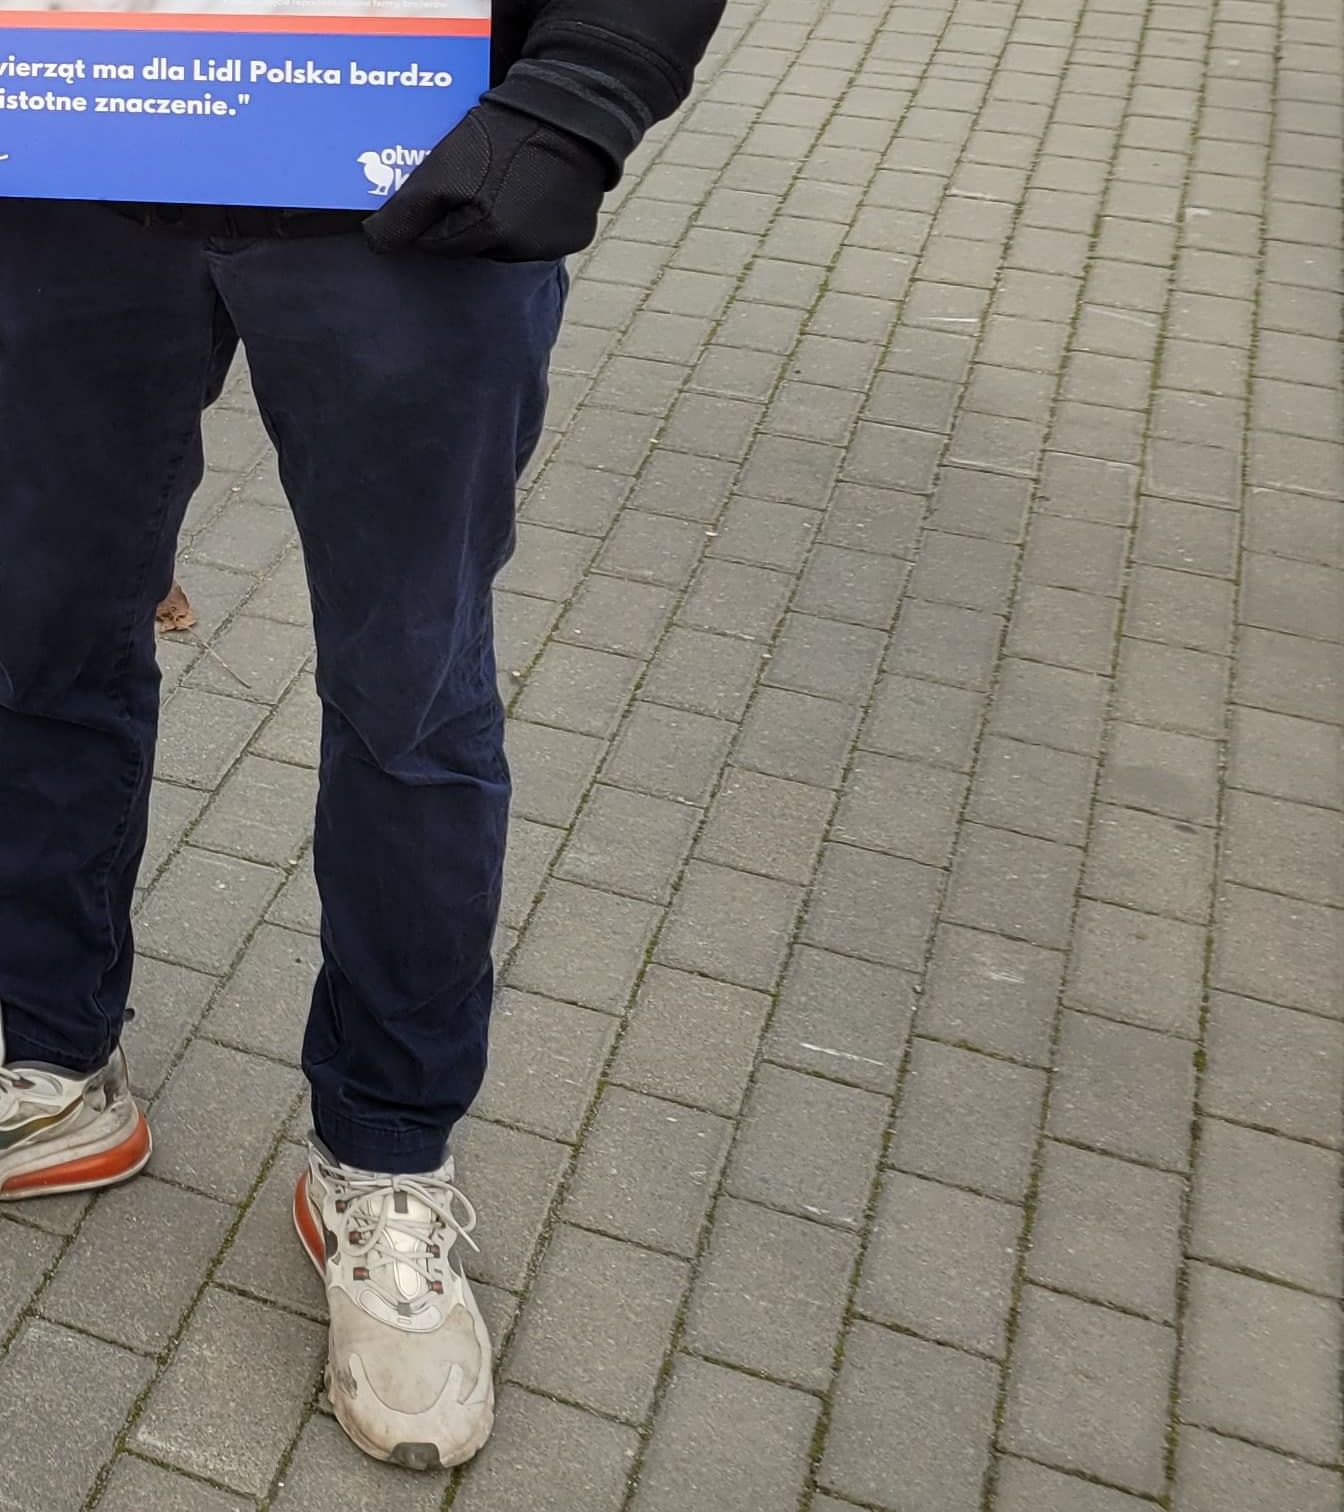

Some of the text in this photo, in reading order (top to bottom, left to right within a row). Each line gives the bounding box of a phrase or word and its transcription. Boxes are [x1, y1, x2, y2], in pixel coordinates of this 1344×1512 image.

[92, 63, 135, 80] ma
[142, 57, 185, 81] dla
[193, 58, 241, 82] Lidl
[249, 60, 341, 85] Polska
[349, 61, 453, 87] bardzo
[94, 93, 251, 116] znaczenie."
